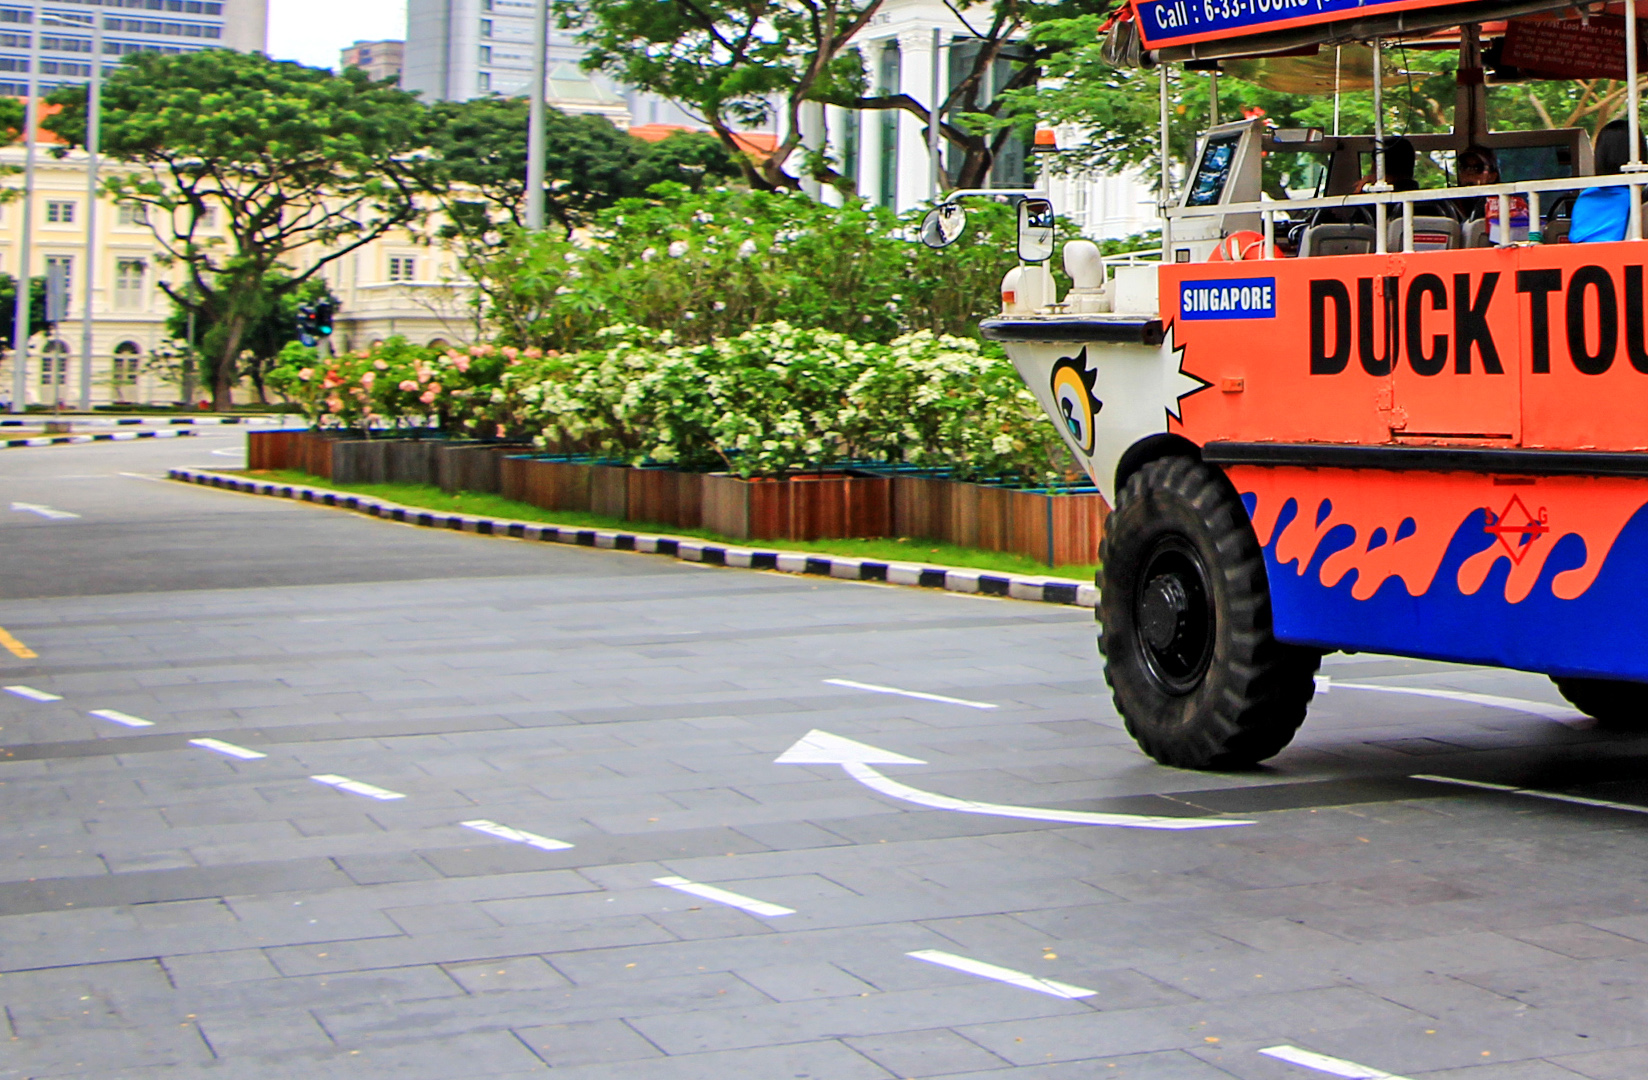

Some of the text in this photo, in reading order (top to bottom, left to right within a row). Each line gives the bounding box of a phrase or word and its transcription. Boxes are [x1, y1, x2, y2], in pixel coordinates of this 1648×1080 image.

[1154, 0, 1189, 29] Call
[1182, 285, 1273, 313] SINGAPORE
[1308, 270, 1505, 376] DUCK
